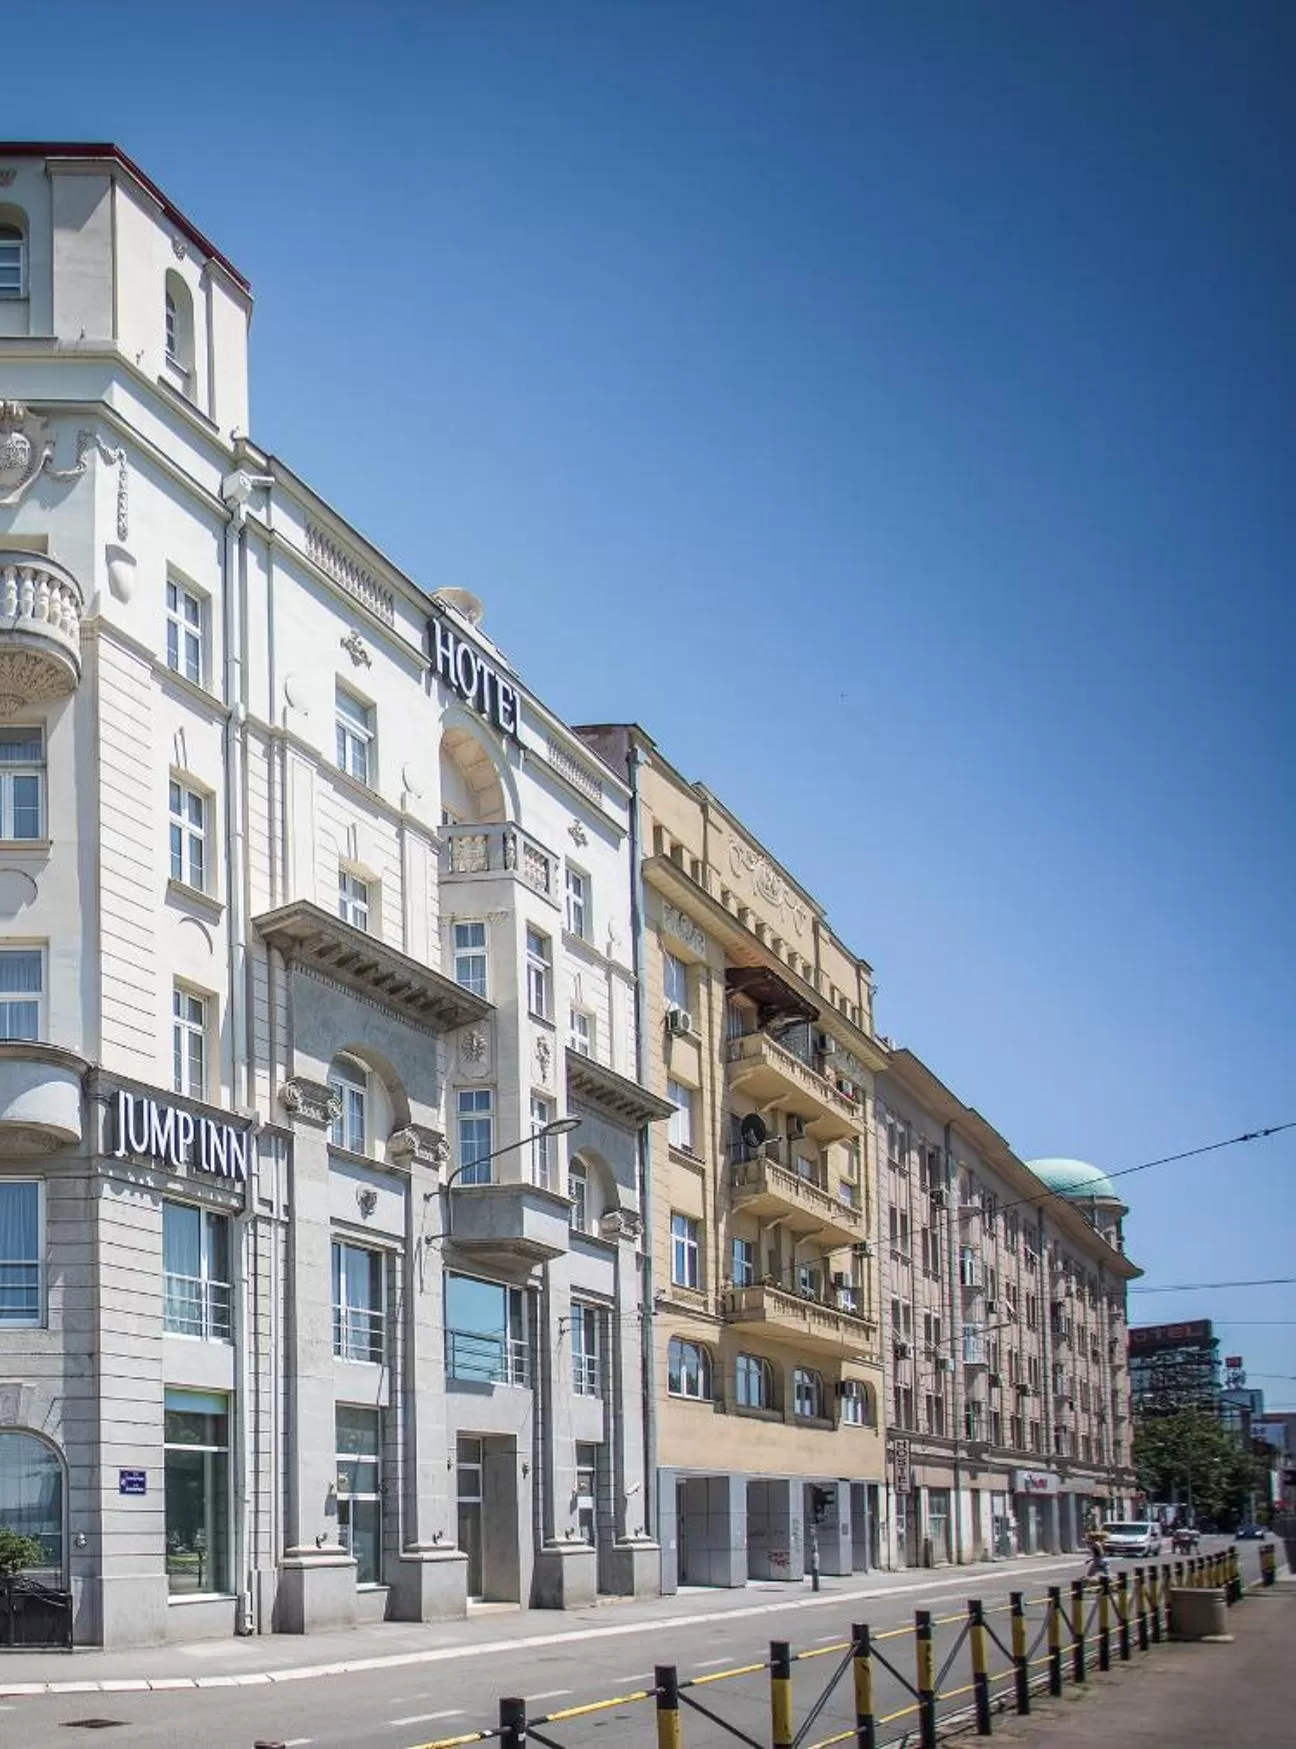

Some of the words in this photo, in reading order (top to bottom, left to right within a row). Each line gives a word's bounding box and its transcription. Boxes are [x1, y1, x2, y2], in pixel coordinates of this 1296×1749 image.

[432, 617, 526, 750] HOTEL
[114, 1089, 194, 1166] JUMP
[200, 1117, 247, 1181] INN
